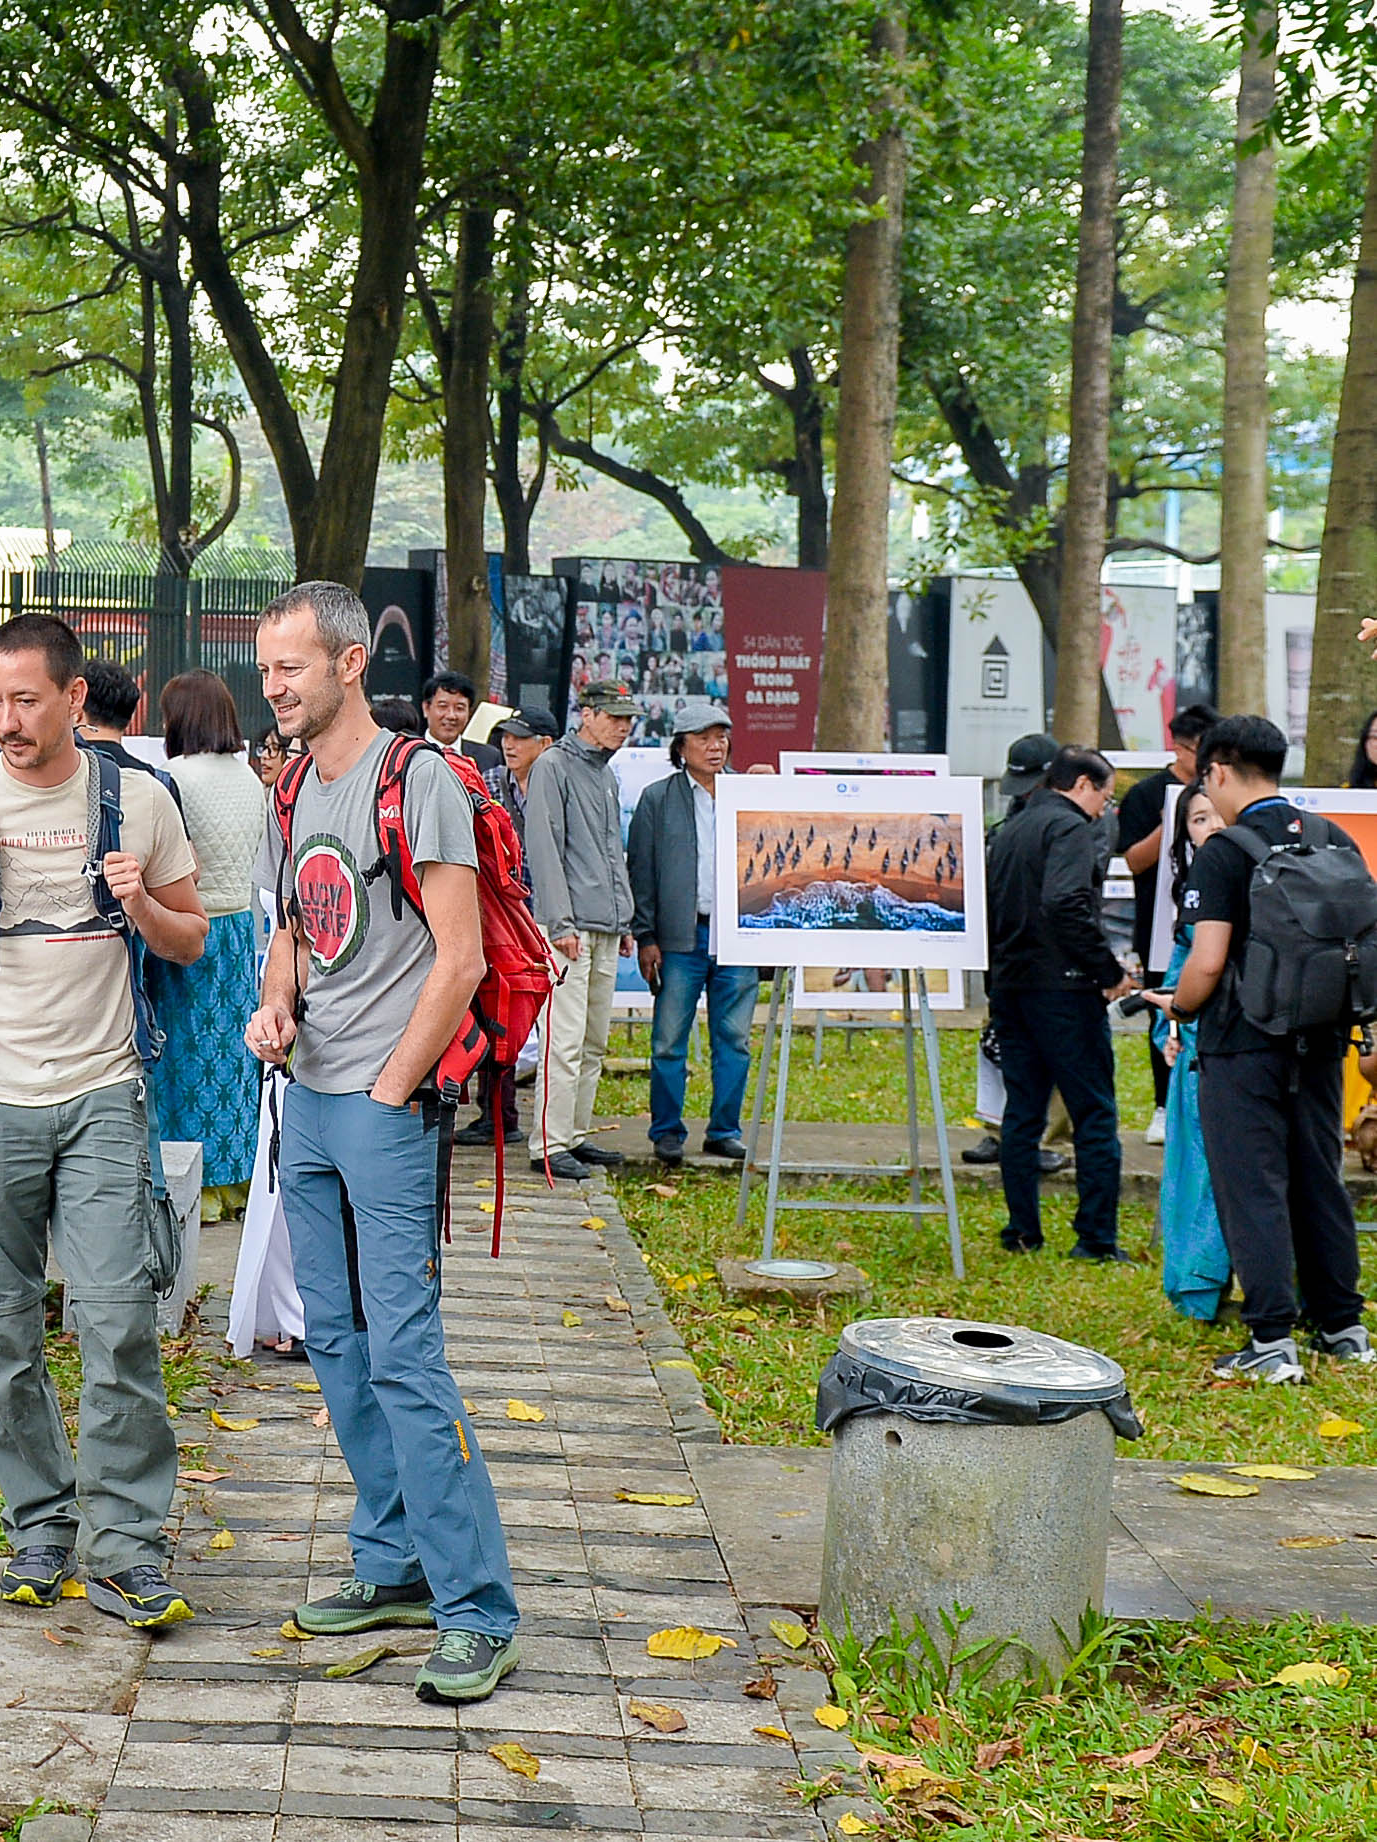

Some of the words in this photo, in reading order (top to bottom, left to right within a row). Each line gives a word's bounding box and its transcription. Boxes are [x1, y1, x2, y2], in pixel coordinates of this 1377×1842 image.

[734, 651, 778, 669] THỐNG
[779, 652, 812, 670] NHẤT
[752, 672, 794, 688] TRONG
[745, 689, 765, 705] ĐA
[765, 689, 800, 708] DẠNG
